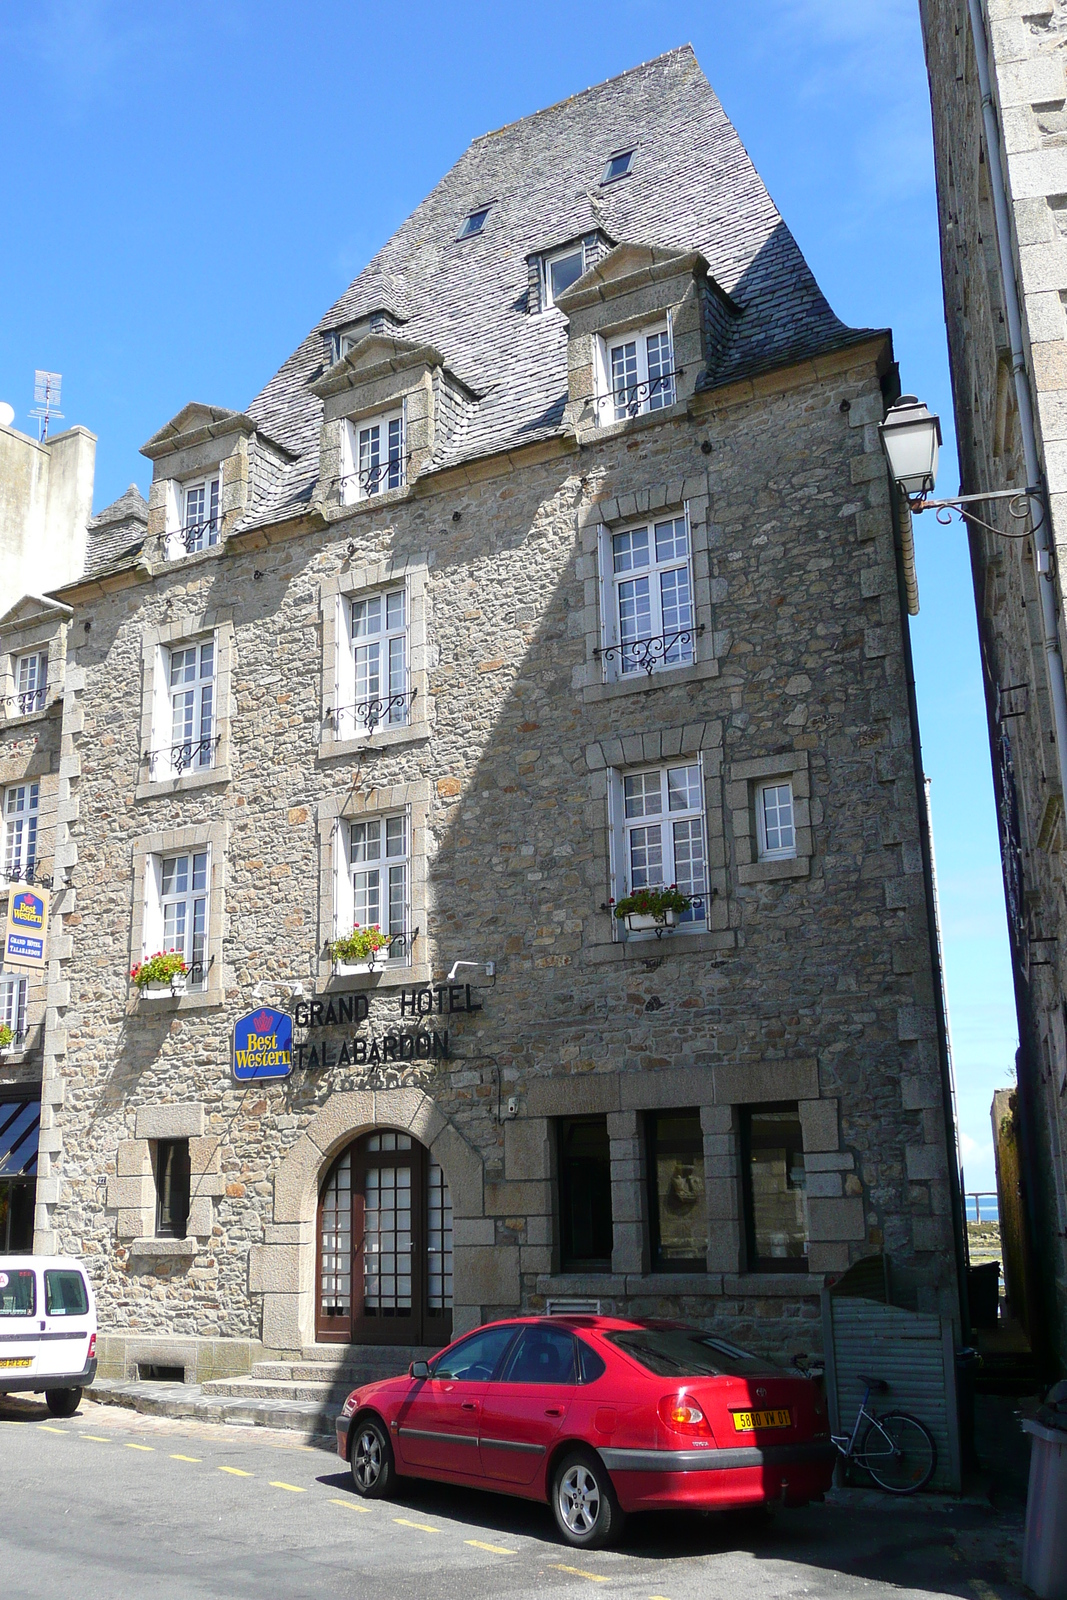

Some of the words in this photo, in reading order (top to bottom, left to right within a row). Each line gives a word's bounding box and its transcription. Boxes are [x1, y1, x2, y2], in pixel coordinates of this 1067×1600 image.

[14, 908, 42, 923] Western
[20, 902, 36, 914] Best
[10, 936, 26, 946] GRAND
[295, 995, 369, 1028] GRAND
[401, 983, 483, 1017] HOTEL
[247, 1032, 278, 1052] Best
[295, 1030, 449, 1070] TALABARDON
[235, 1050, 292, 1069] Western
[740, 1412, 762, 1428] 5880
[777, 1410, 789, 1425] 01
